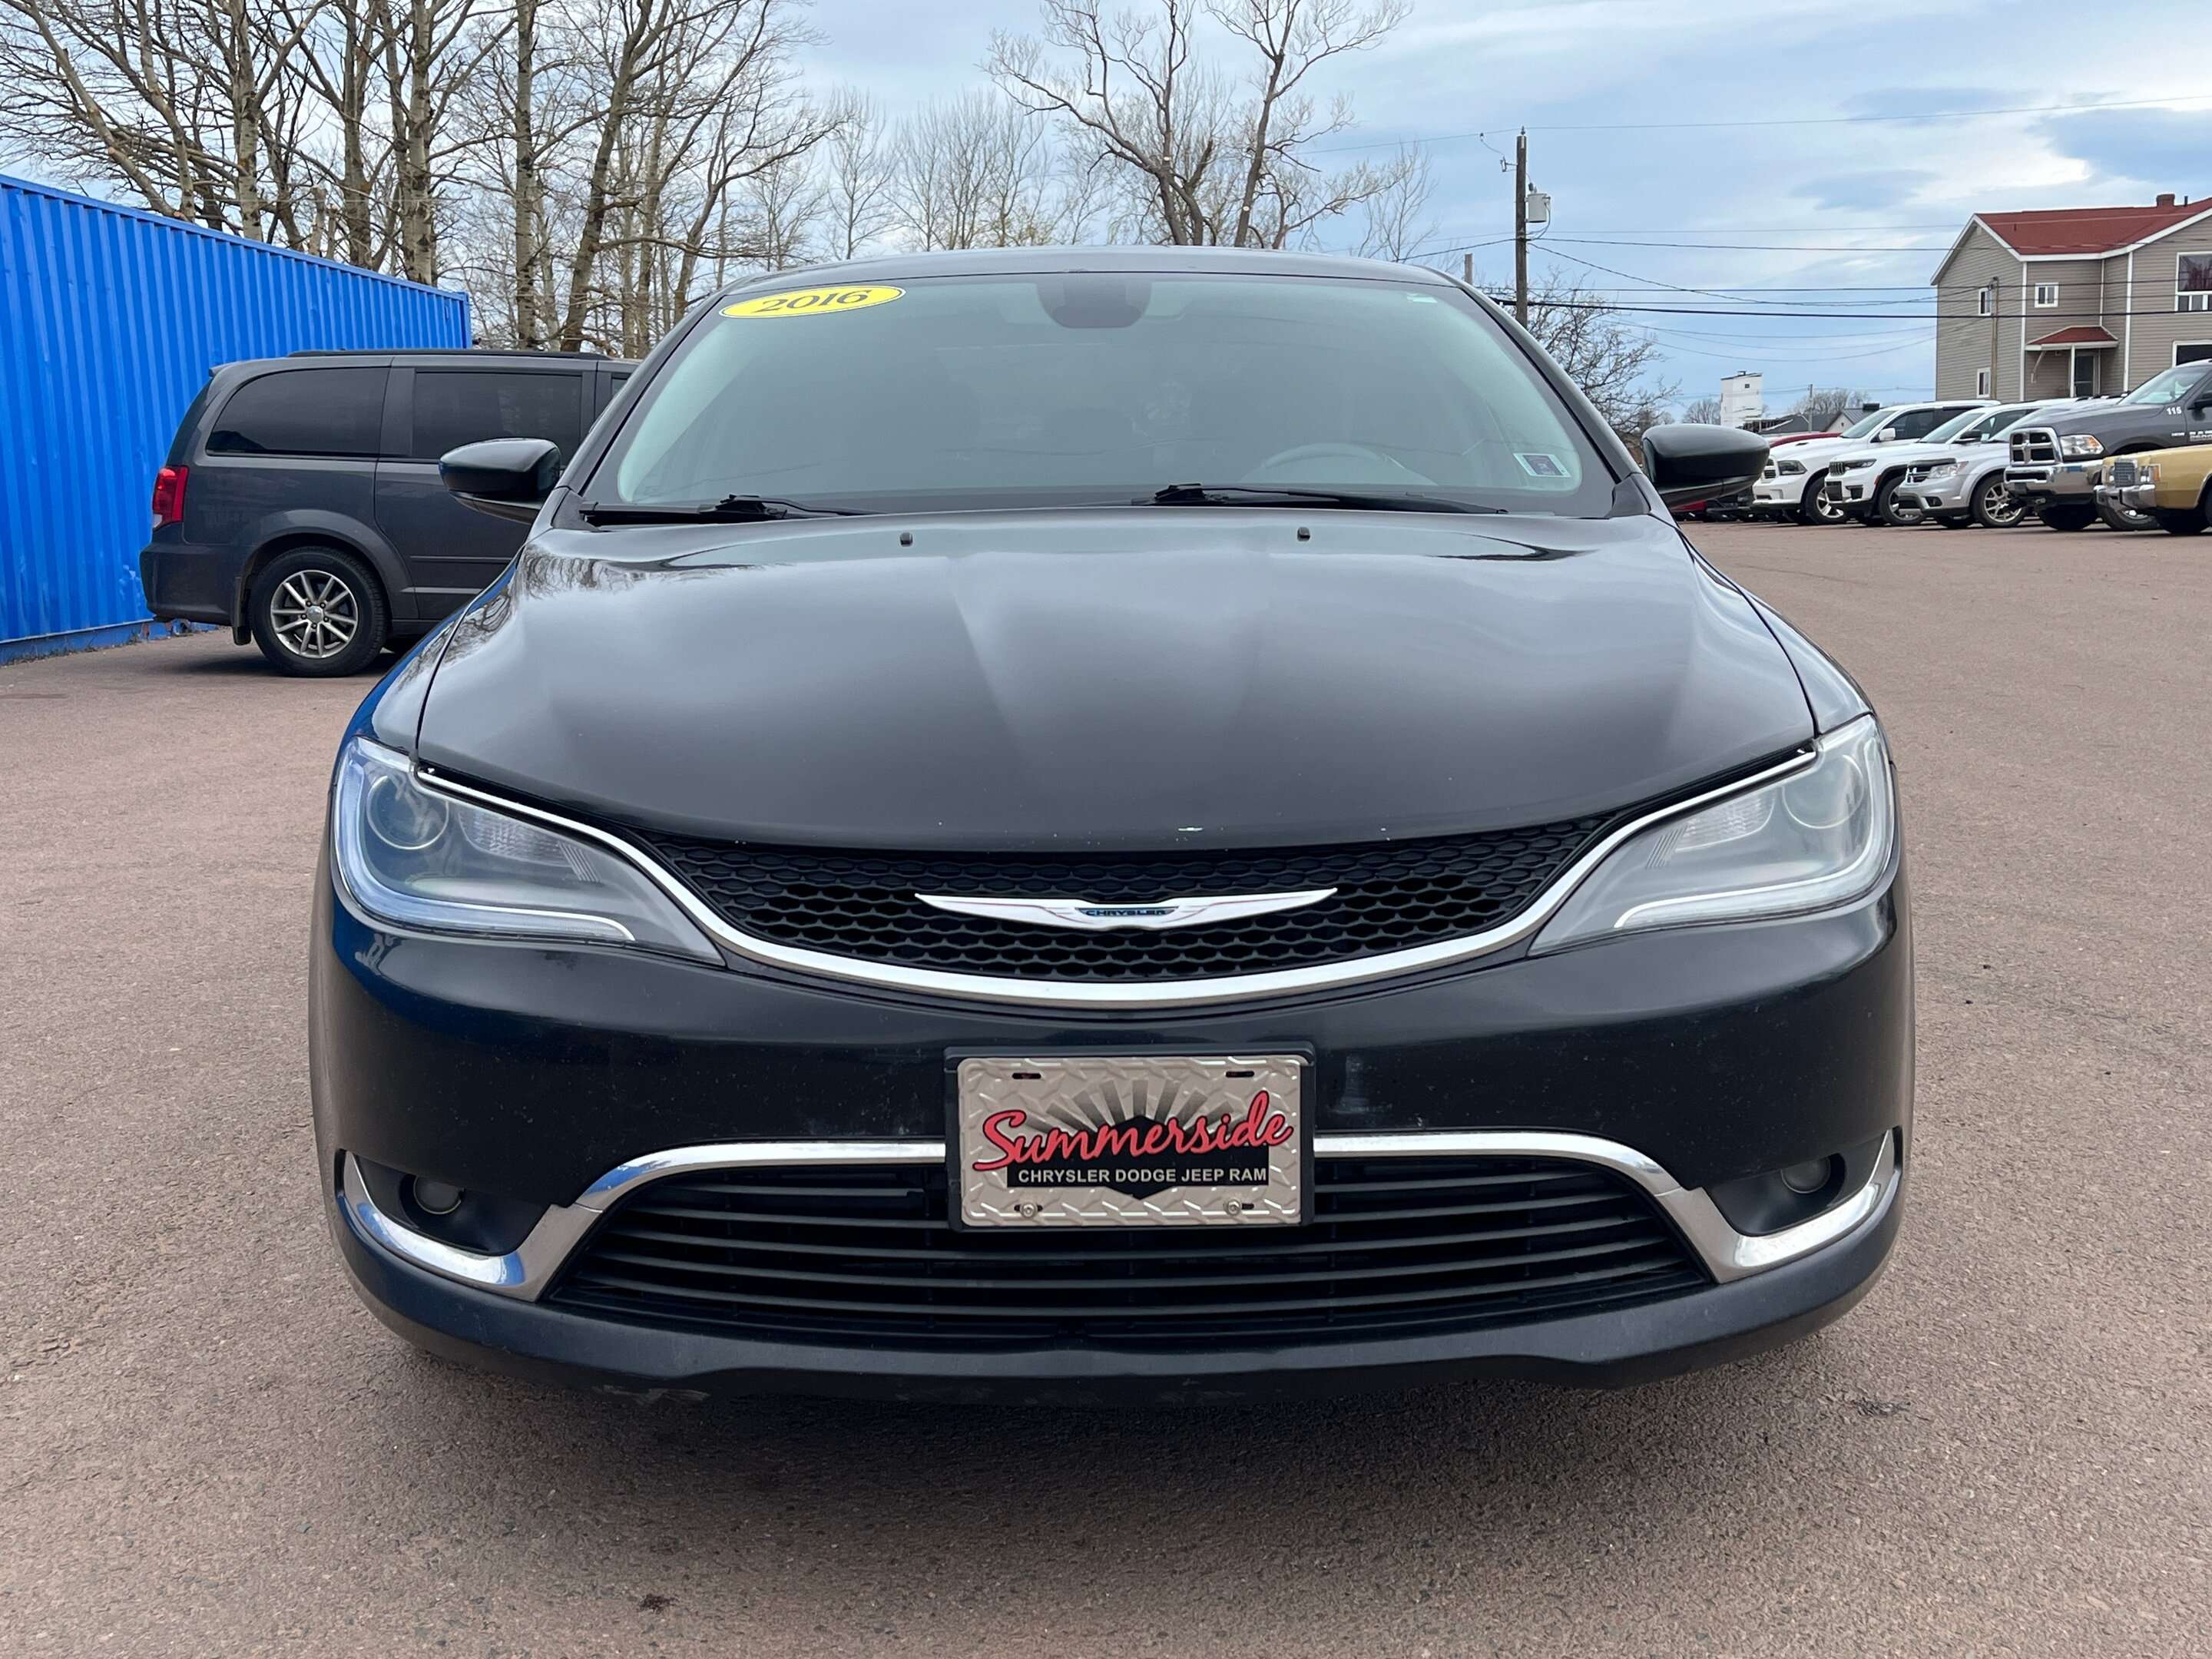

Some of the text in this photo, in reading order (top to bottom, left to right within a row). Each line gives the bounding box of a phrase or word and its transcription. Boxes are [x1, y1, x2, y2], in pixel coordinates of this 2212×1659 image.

[751, 289, 872, 313] 2016
[972, 1090, 1294, 1171] Summerside
[1018, 1167, 1267, 1184] CHRYSLER DODGE JEEP RAM
